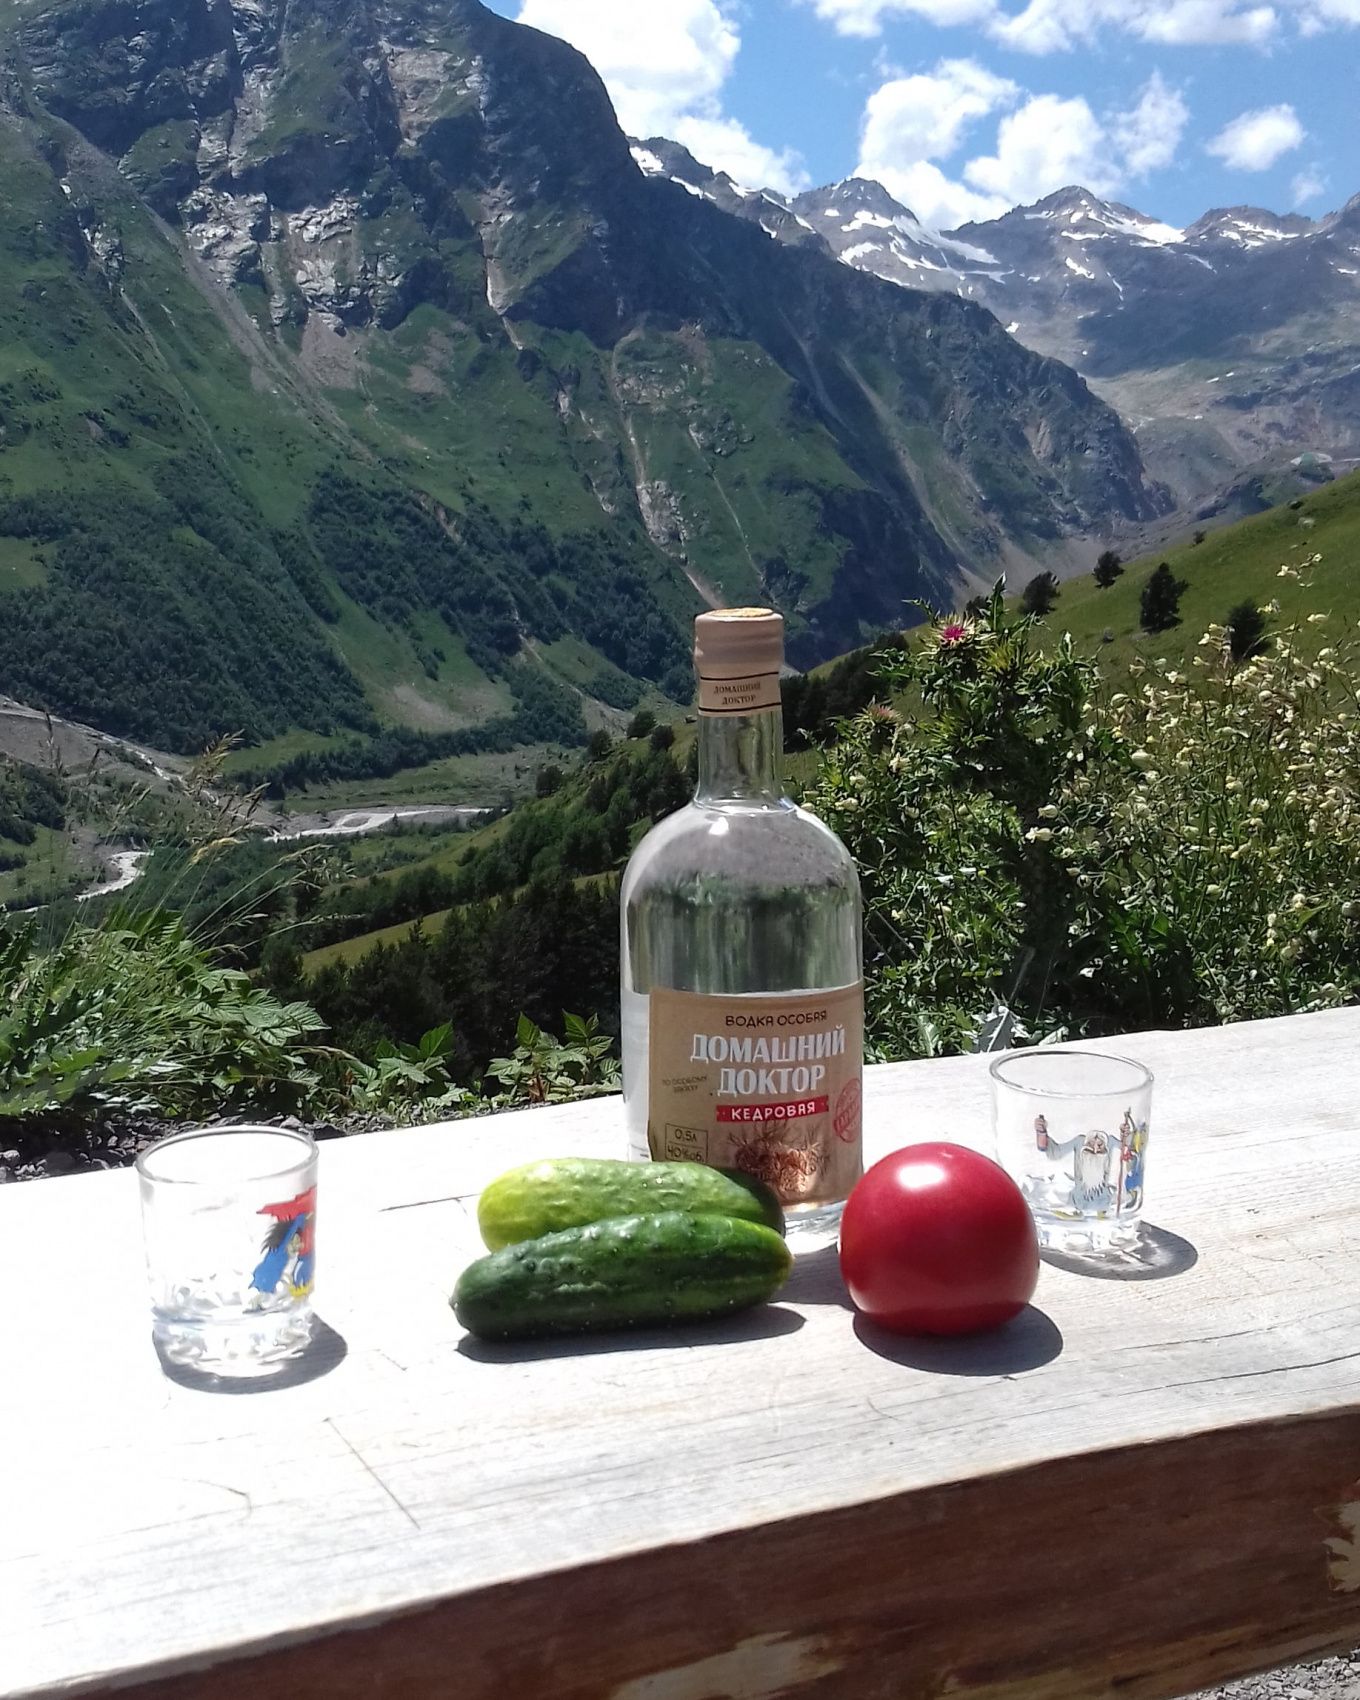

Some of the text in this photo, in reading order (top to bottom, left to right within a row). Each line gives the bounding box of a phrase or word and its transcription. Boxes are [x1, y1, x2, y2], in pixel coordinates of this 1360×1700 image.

[714, 682, 761, 695] ДОМАШНИЙ
[722, 695, 756, 705] ДОКТОР
[725, 1010, 828, 1028] ВОДКА ОСОБАЯ
[690, 1024, 845, 1064] ДОМАШНИЙ
[717, 1064, 826, 1098] ДОКТОР
[731, 1101, 816, 1121] КЕДРОВАЯ
